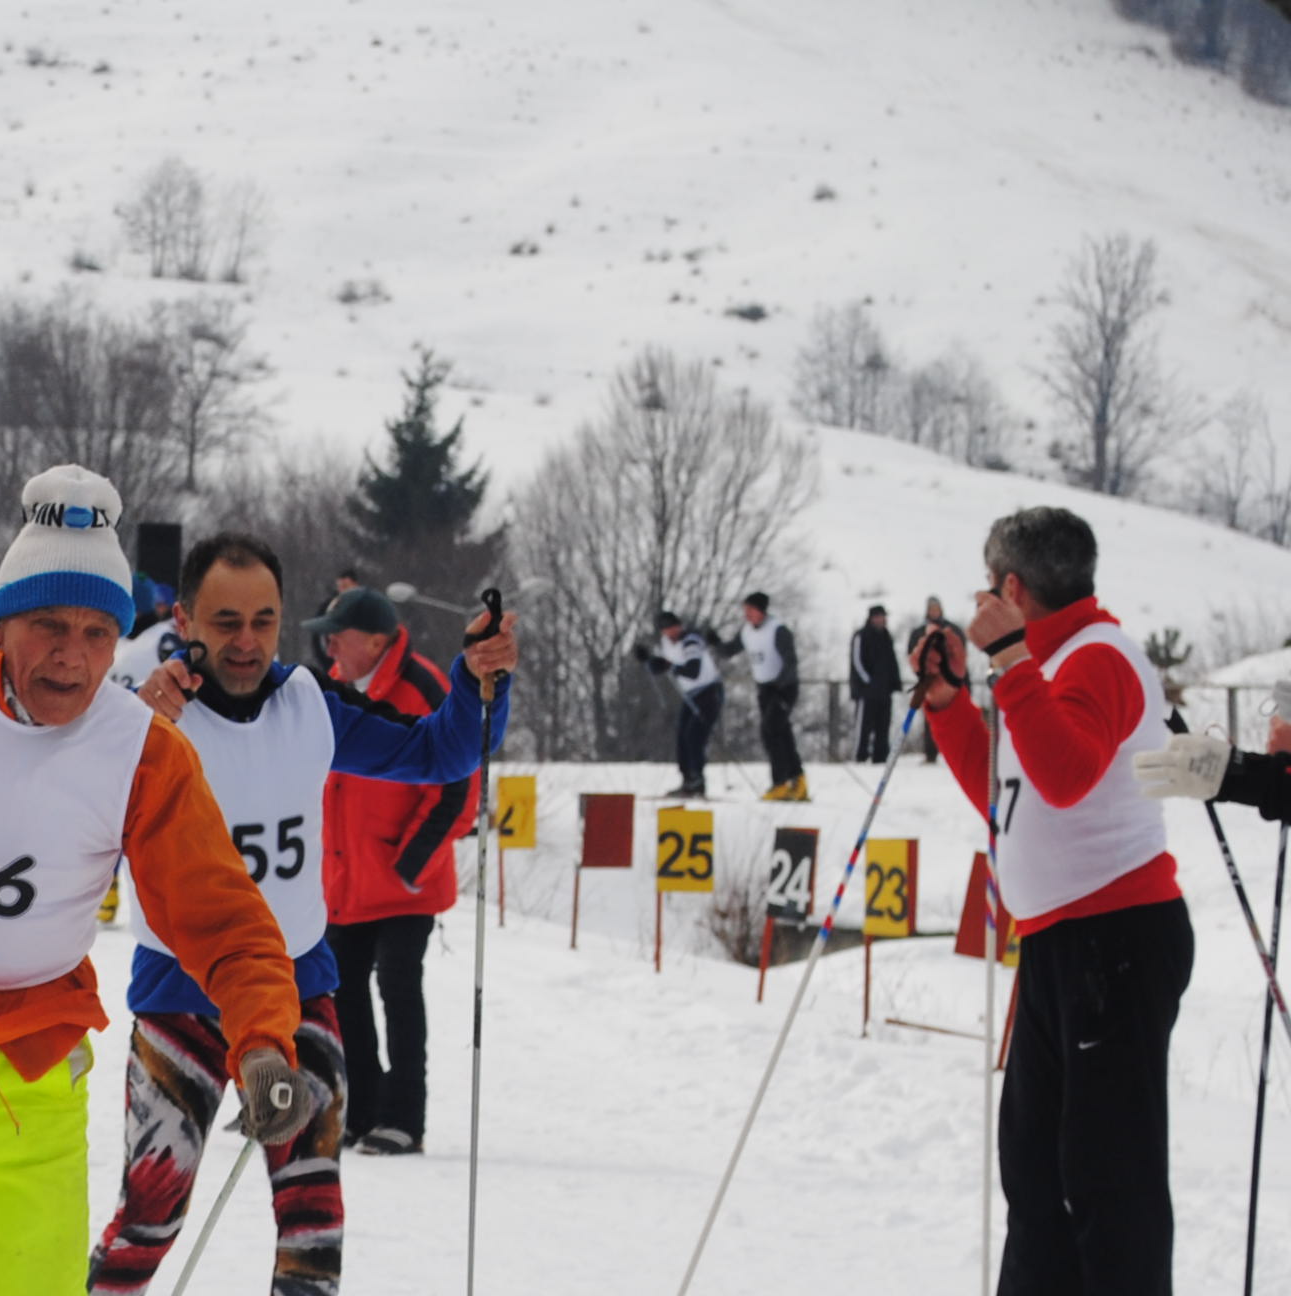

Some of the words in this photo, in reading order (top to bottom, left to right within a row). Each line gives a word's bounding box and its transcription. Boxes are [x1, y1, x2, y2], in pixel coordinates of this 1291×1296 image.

[996, 776, 1021, 835] 7
[232, 814, 305, 884] 55
[658, 830, 713, 880] 25
[769, 849, 811, 914] 24
[865, 861, 909, 922] 23
